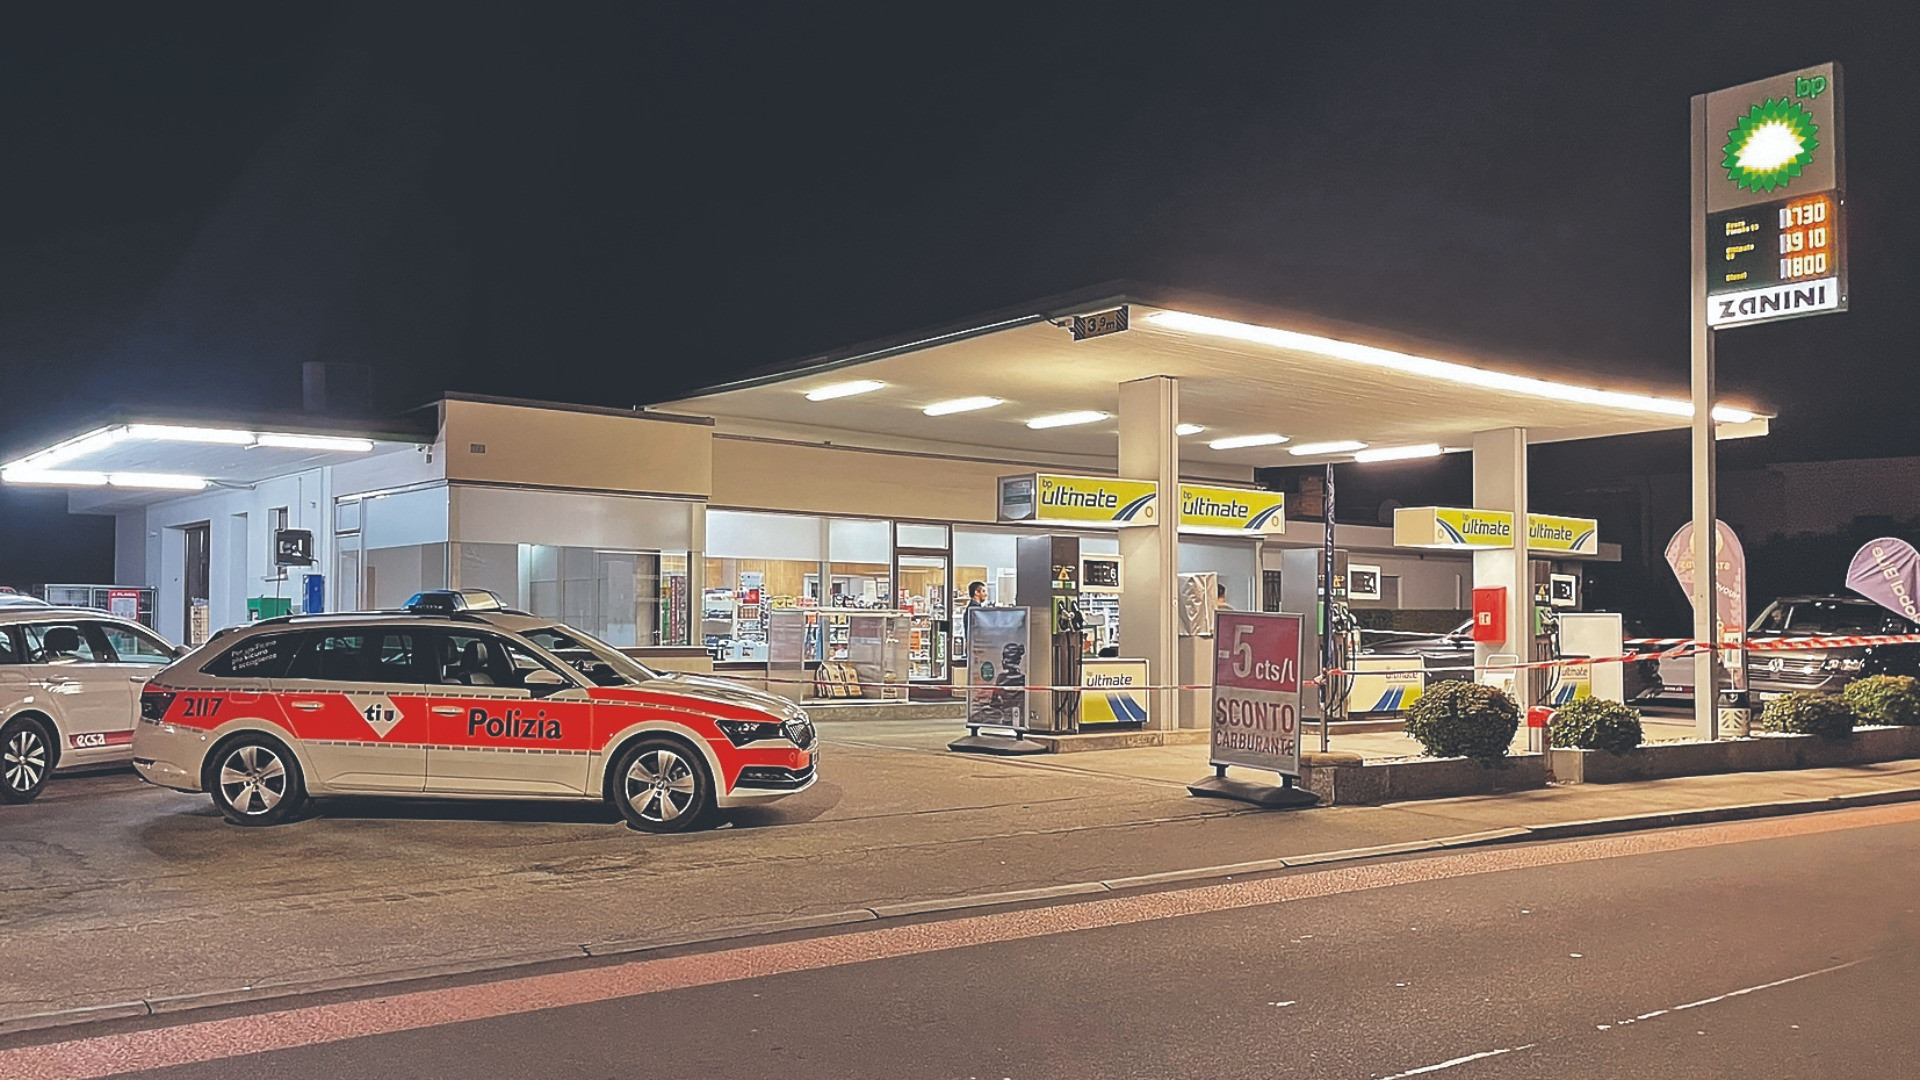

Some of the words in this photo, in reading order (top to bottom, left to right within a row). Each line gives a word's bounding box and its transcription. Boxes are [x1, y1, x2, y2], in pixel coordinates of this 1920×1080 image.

[1796, 76, 1826, 99] bp
[1719, 286, 1825, 318] ZANINI
[1042, 479, 1053, 489] bp
[1042, 486, 1118, 509] ultimate
[1183, 490, 1193, 501] bp
[1183, 497, 1249, 518] ultimate
[1462, 519, 1510, 536] ultimate
[1529, 523, 1573, 541] ultimate
[1218, 624, 1255, 678] -5
[1255, 657, 1295, 684] cts/l
[1086, 673, 1133, 687] ultimate
[183, 697, 223, 717] 2117
[1216, 697, 1295, 734] SCONTO
[467, 707, 563, 740] Polizia
[1215, 729, 1295, 757] CARBURANTE
